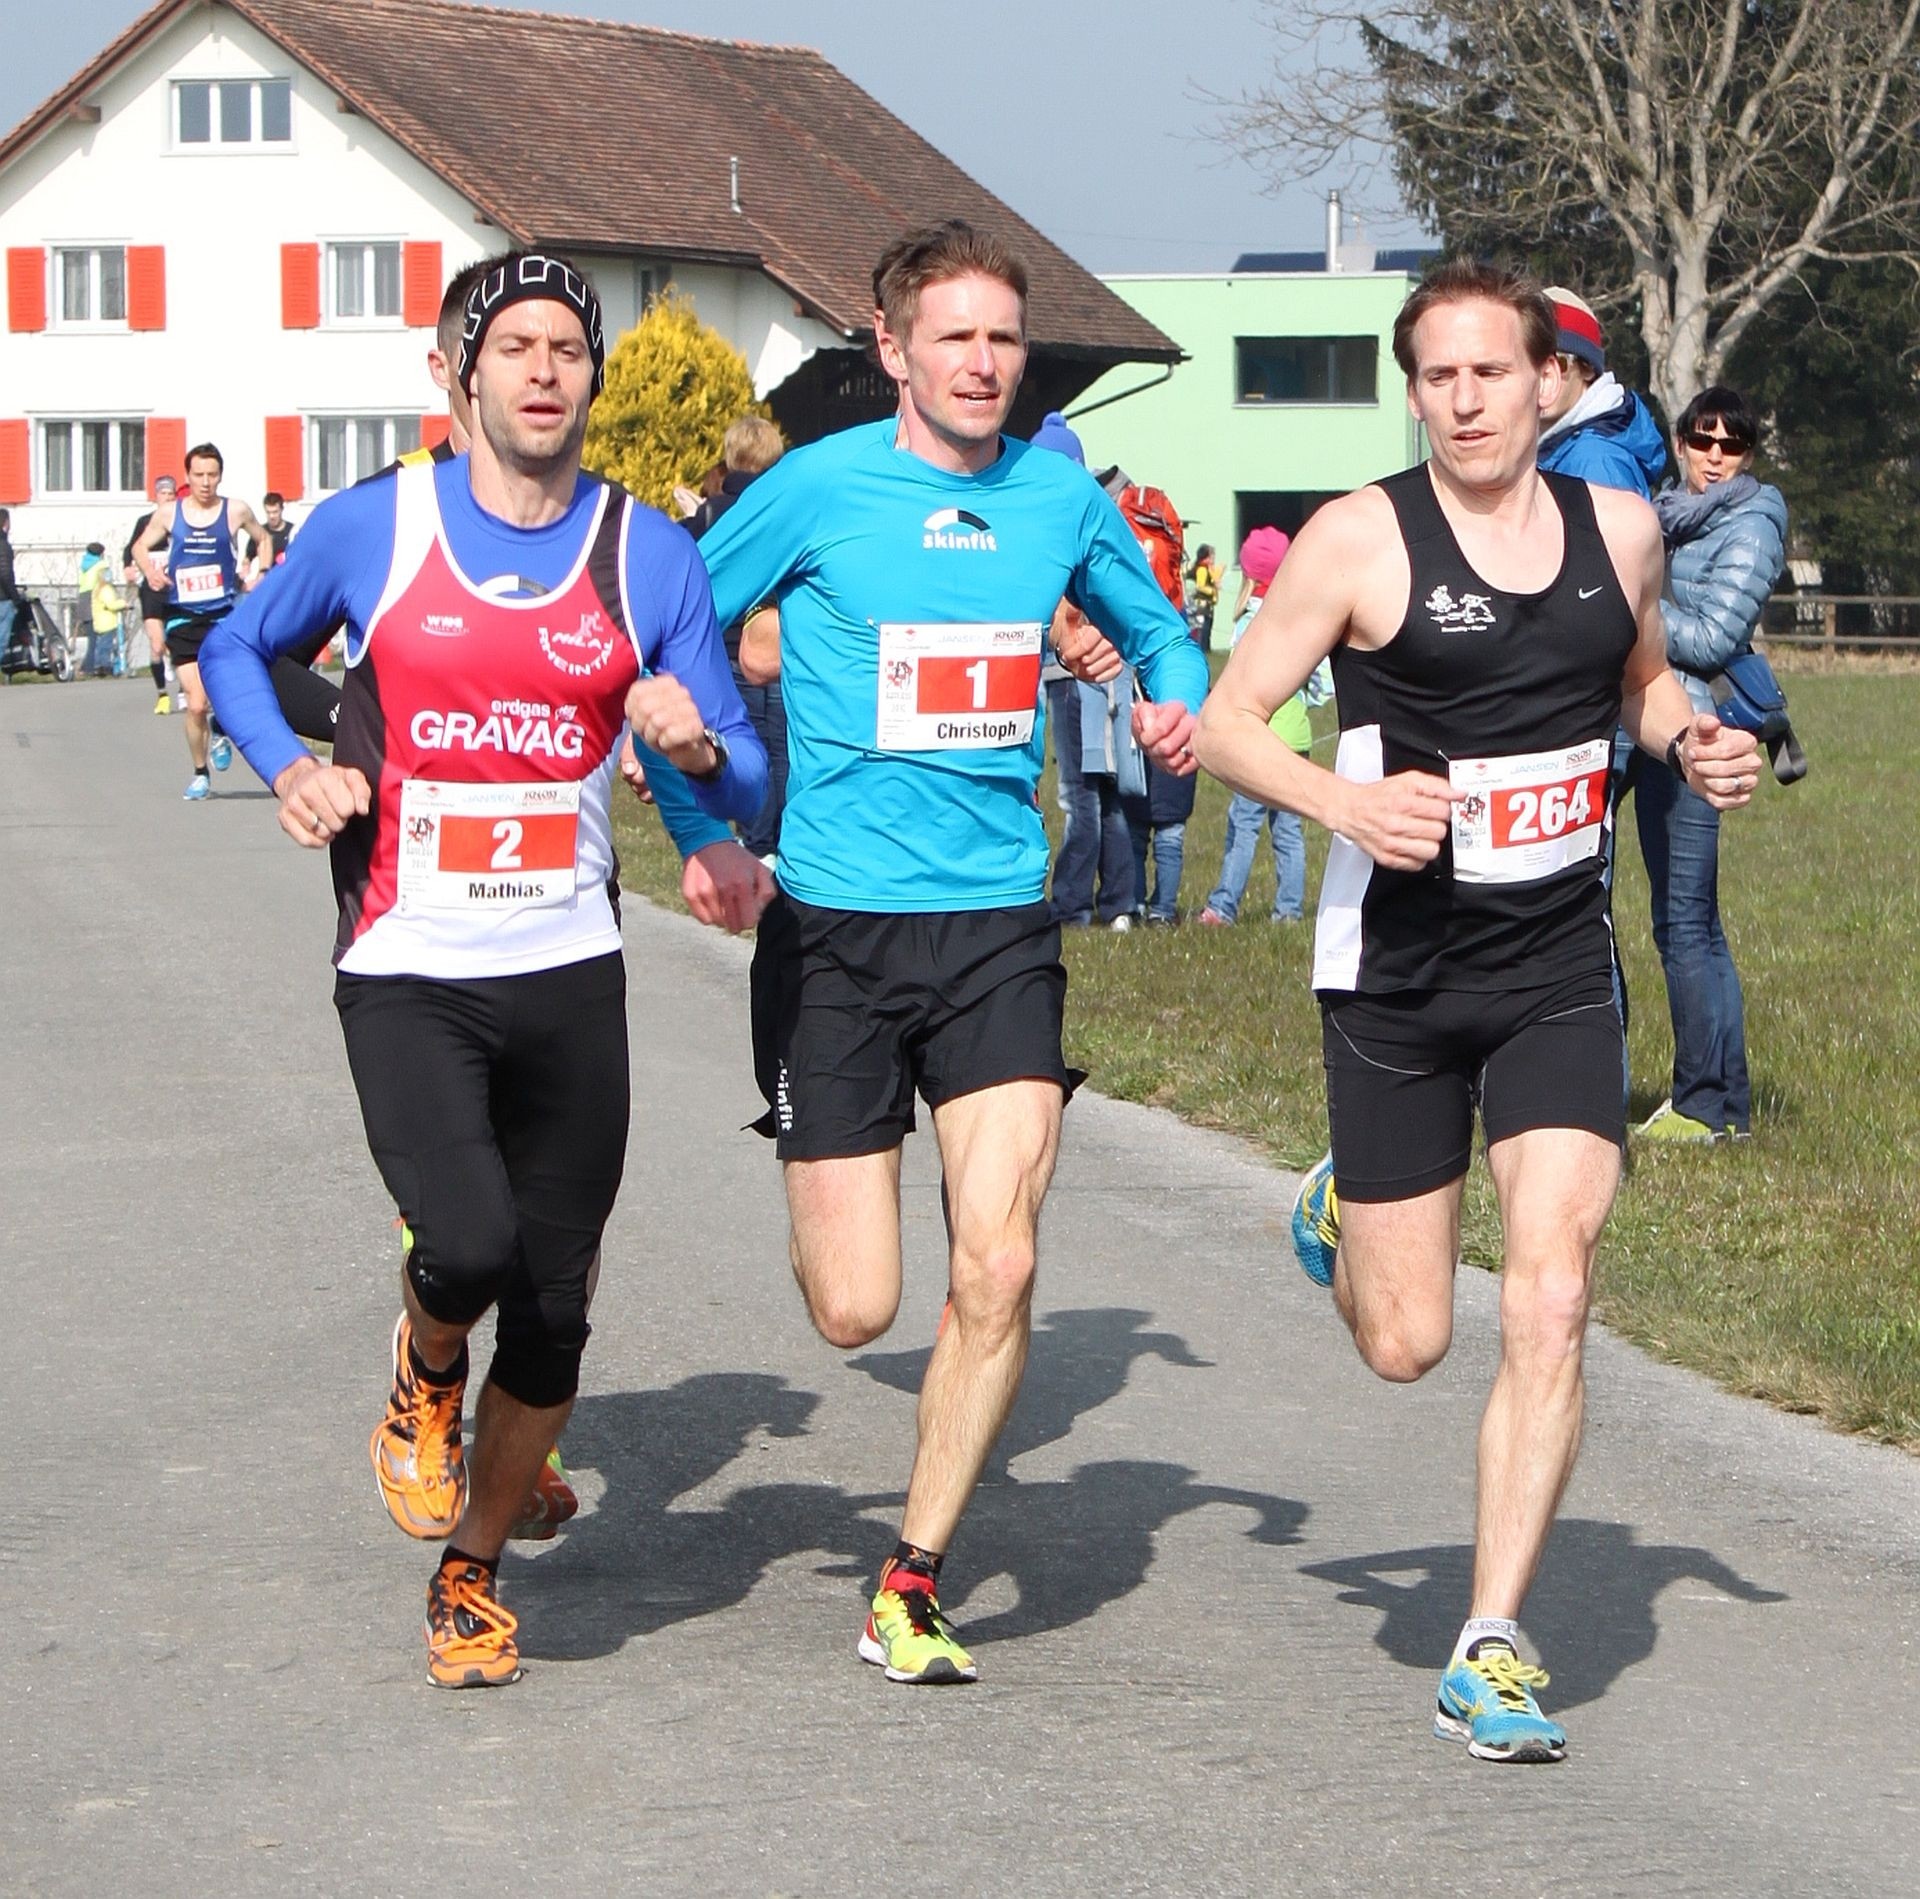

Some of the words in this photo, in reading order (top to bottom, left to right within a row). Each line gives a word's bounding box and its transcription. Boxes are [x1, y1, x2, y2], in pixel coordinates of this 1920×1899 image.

[922, 531, 997, 552] skinfit
[538, 626, 614, 677] RHEINTAL
[965, 659, 989, 709] 1
[491, 699, 551, 719] erdgas
[937, 720, 1017, 741] Christoph
[410, 710, 586, 759] GRAVAG
[1507, 778, 1591, 842] 264
[490, 819, 524, 869] 2
[468, 881, 545, 899] Mathias
